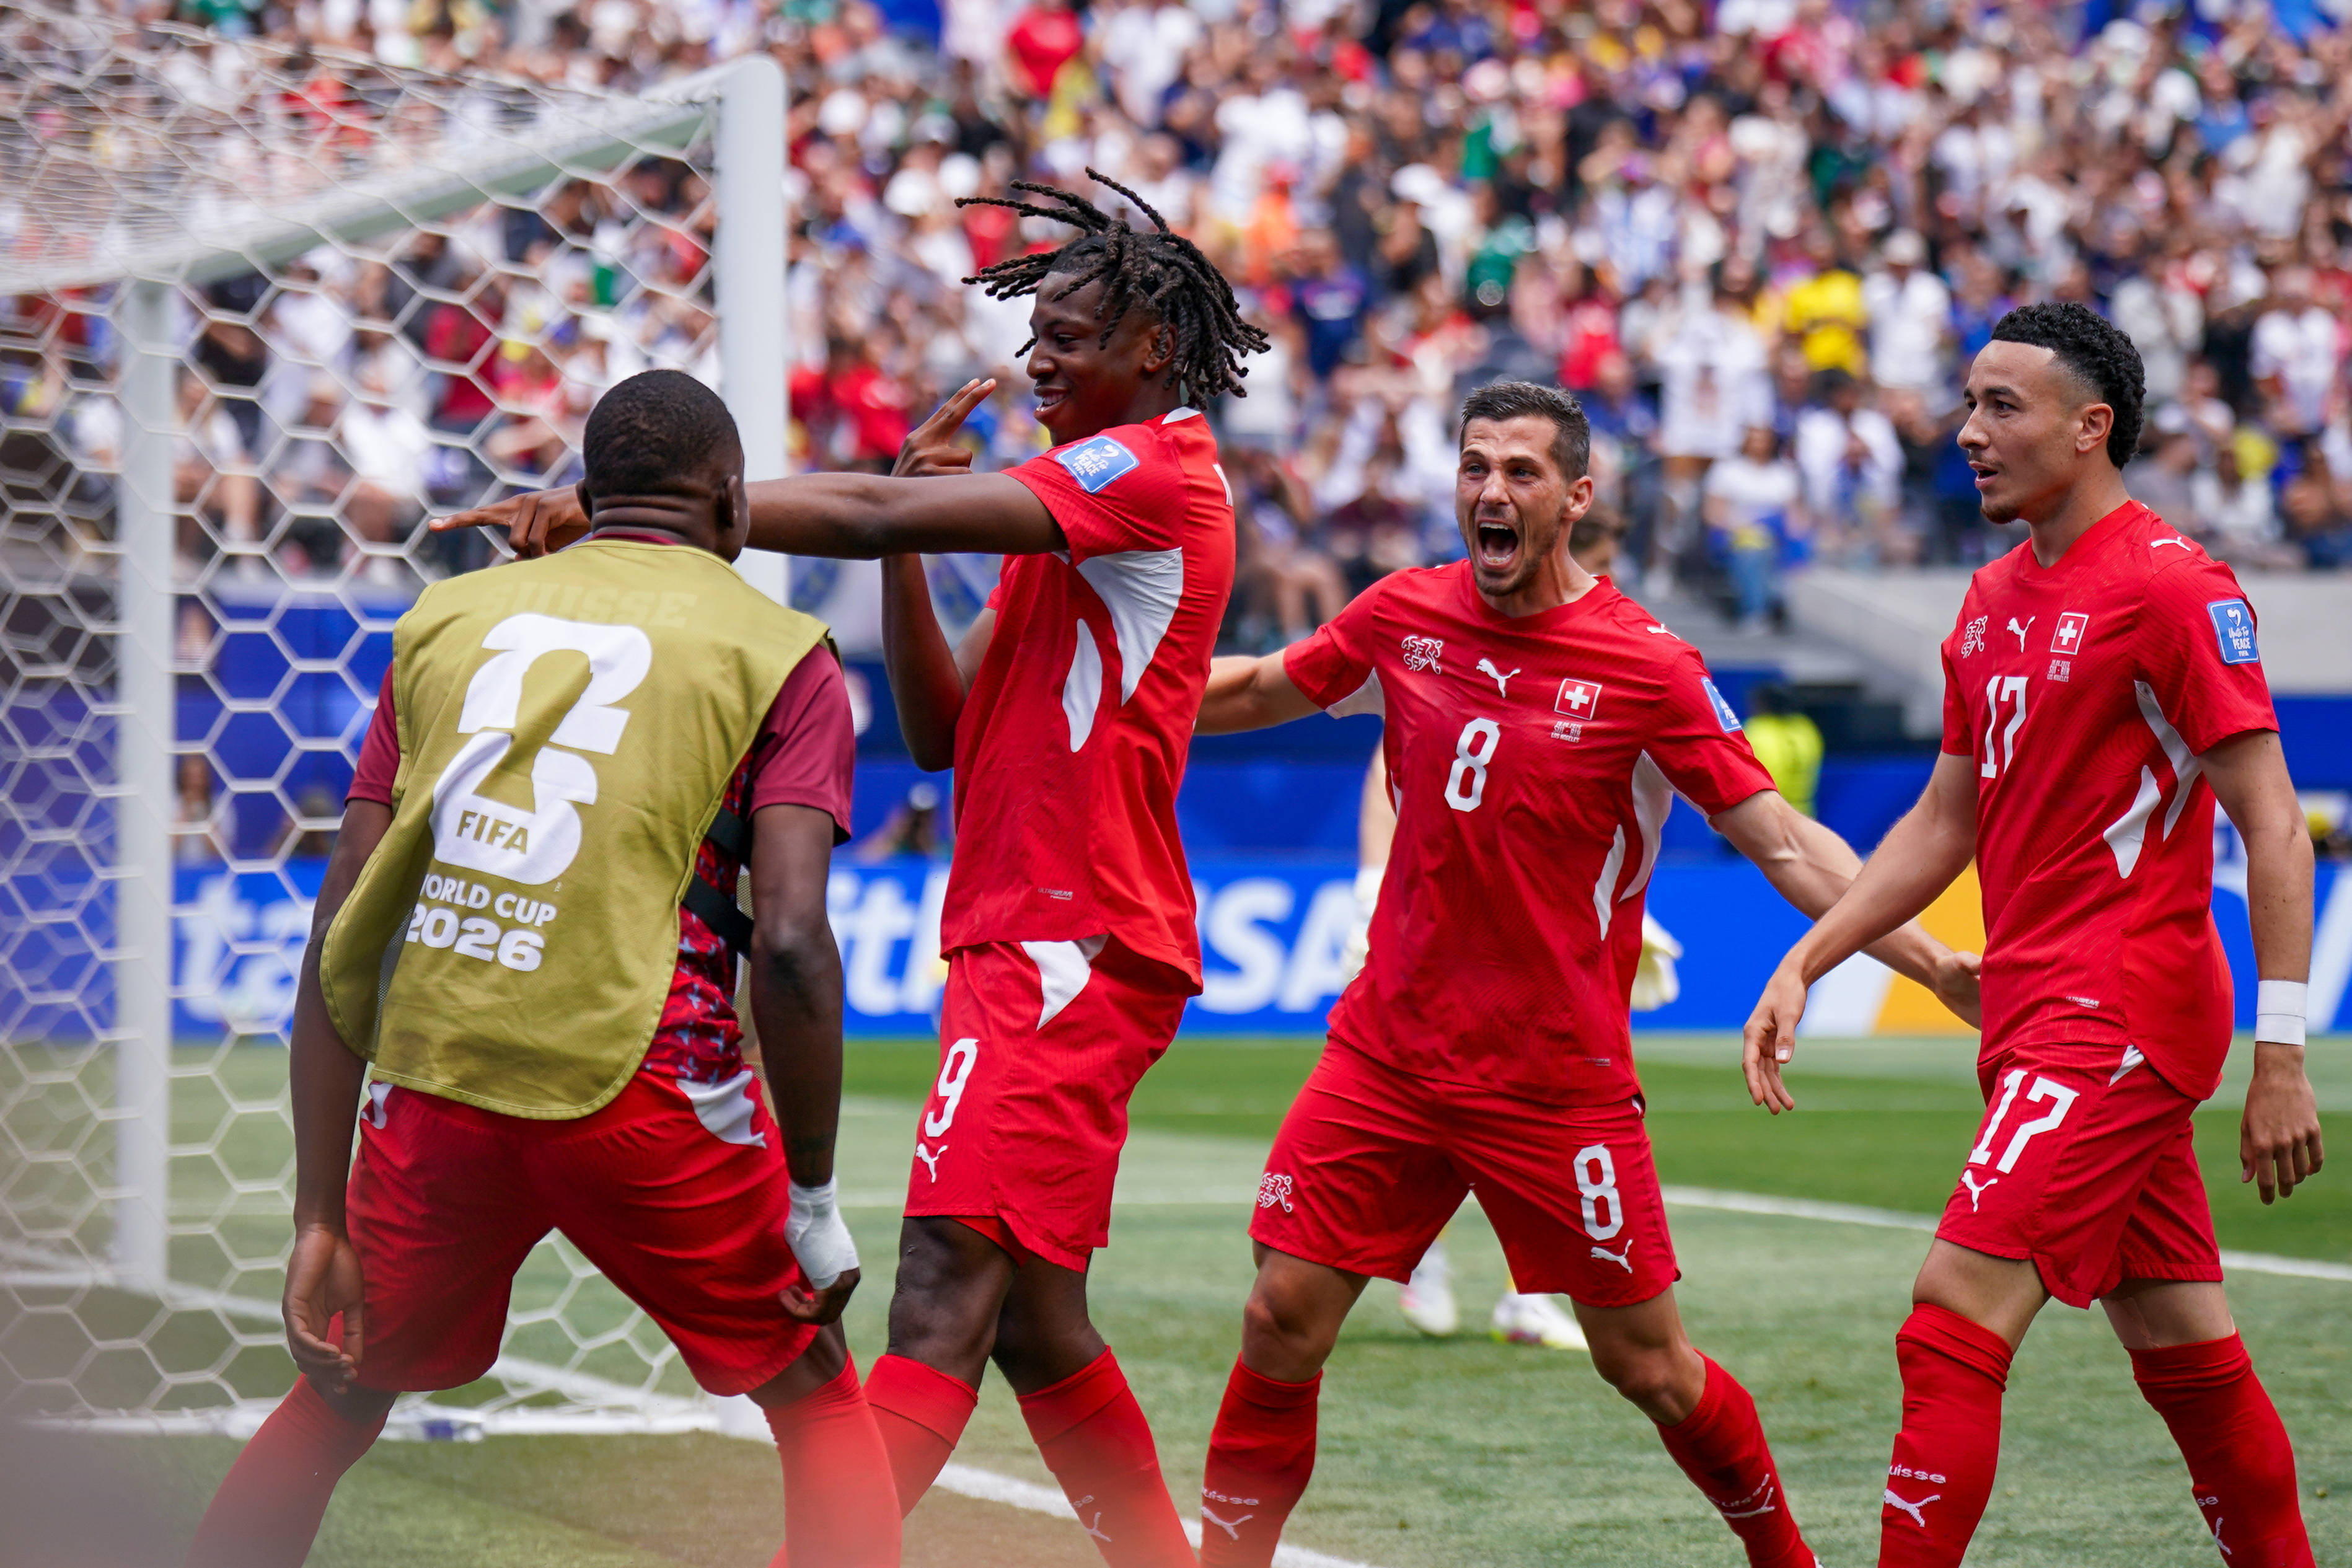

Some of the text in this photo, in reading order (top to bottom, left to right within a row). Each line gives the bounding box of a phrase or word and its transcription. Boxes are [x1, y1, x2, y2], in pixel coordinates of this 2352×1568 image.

[1075, 453, 1101, 477] PEACE
[2232, 638, 2251, 650] PEACE
[1560, 734, 1580, 743] ANGELES
[1981, 676, 2029, 778] 17
[1444, 717, 1501, 813] 8
[456, 809, 529, 855] FIFA
[420, 873, 557, 927] ORLD CUP
[405, 903, 545, 972] 2026
[924, 1038, 980, 1137] 9
[1968, 1070, 2081, 1174] 17
[1572, 1142, 1624, 1241] 8
[1202, 1487, 1259, 1505] uisse
[1888, 1463, 1946, 1484] uisse
